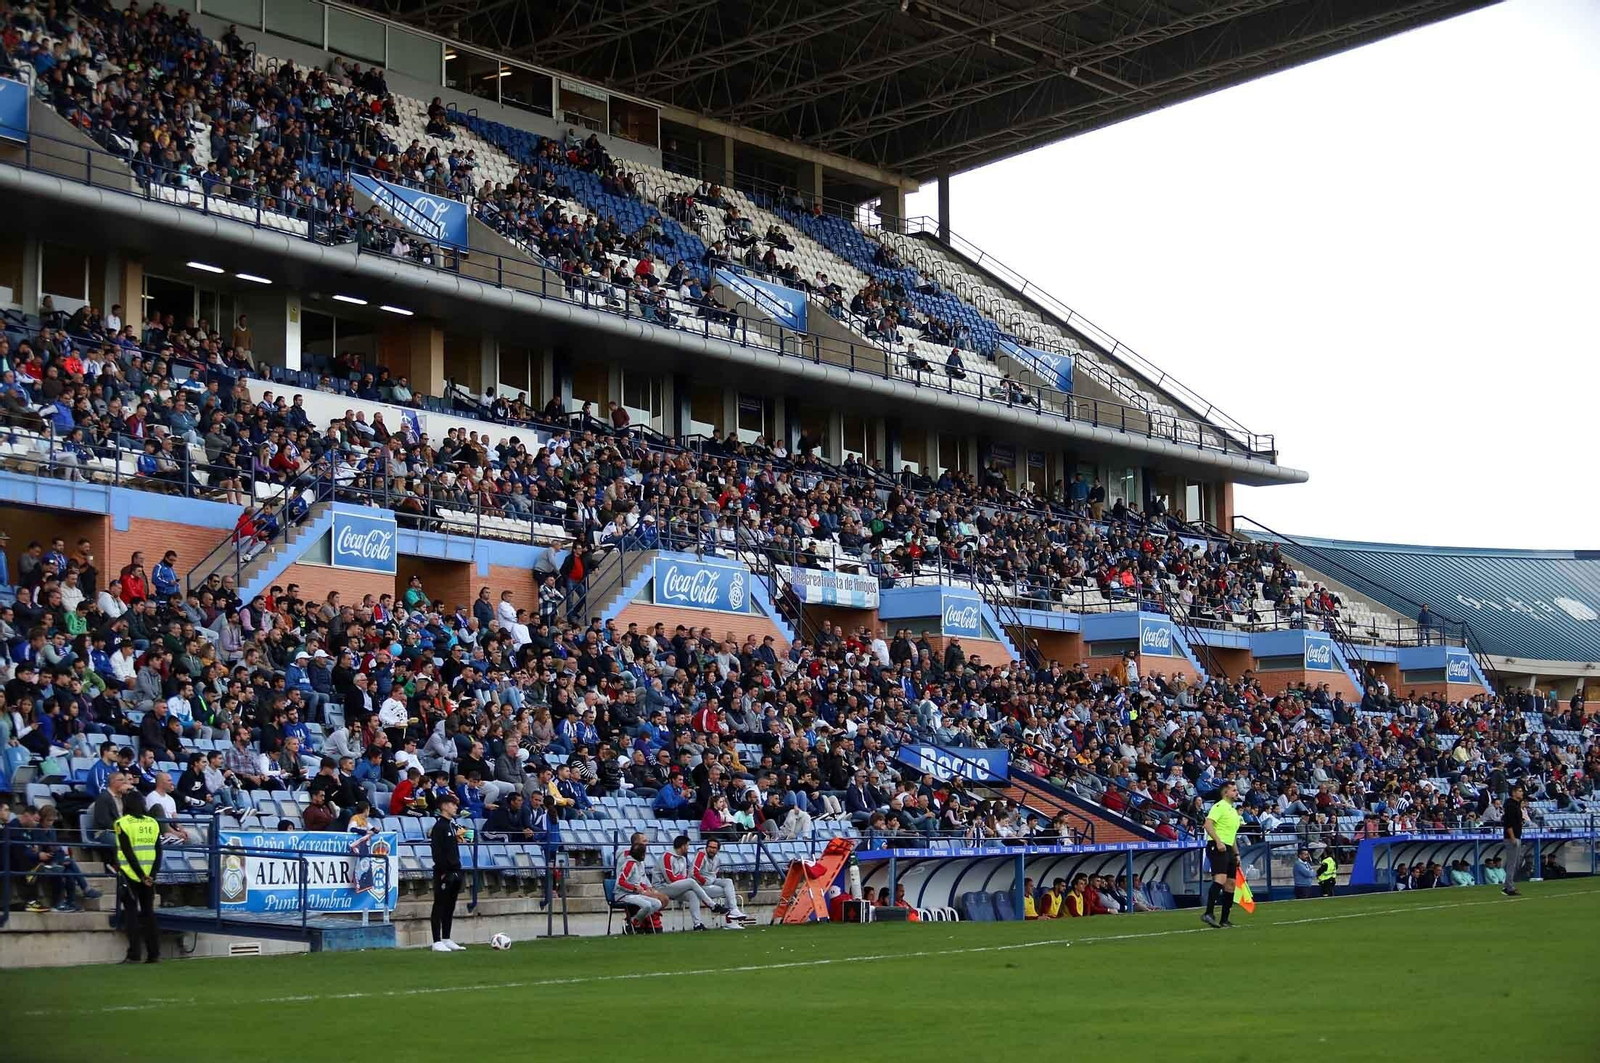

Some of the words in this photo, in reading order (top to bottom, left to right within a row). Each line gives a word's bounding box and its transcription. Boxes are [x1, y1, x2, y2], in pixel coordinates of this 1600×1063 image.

[844, 577, 853, 591] de
[920, 747, 990, 780] Recre
[253, 835, 284, 853] Peña
[255, 861, 355, 885] ALMNAR
[308, 889, 352, 909] Umbría
